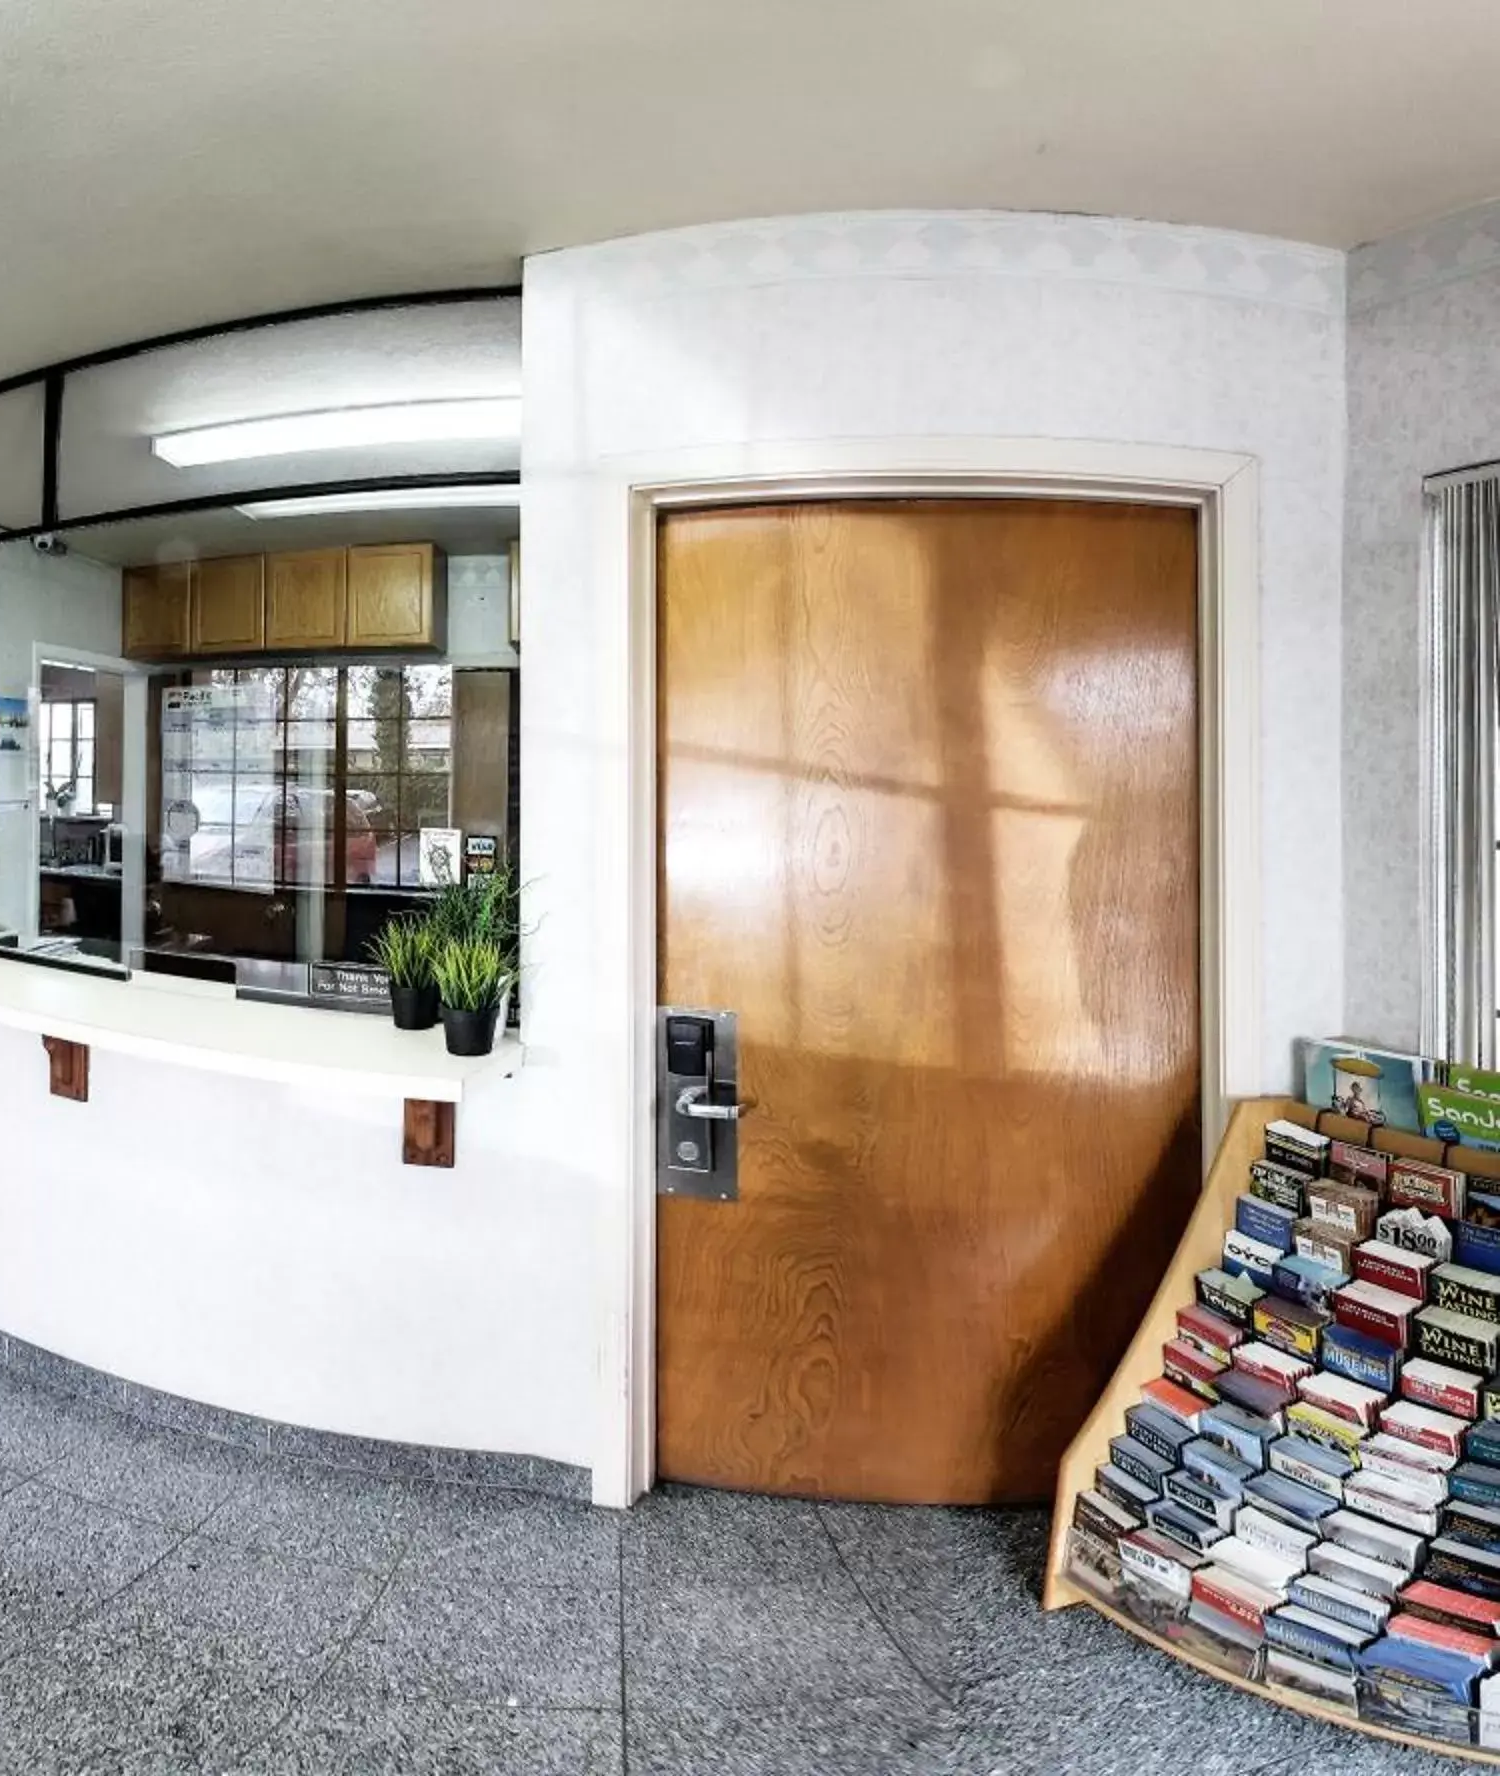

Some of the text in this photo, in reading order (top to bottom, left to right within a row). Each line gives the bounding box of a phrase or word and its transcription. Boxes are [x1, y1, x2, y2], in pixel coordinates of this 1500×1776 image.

[317, 982, 335, 991] For
[339, 983, 358, 994] Not
[337, 971, 369, 983] Thank
[1436, 1295, 1499, 1324] TASTING
[1437, 1281, 1496, 1311] WINE
[1420, 1341, 1483, 1369] TASTING
[1421, 1326, 1480, 1356] WINE
[1323, 1349, 1388, 1383] MUSEUMS
